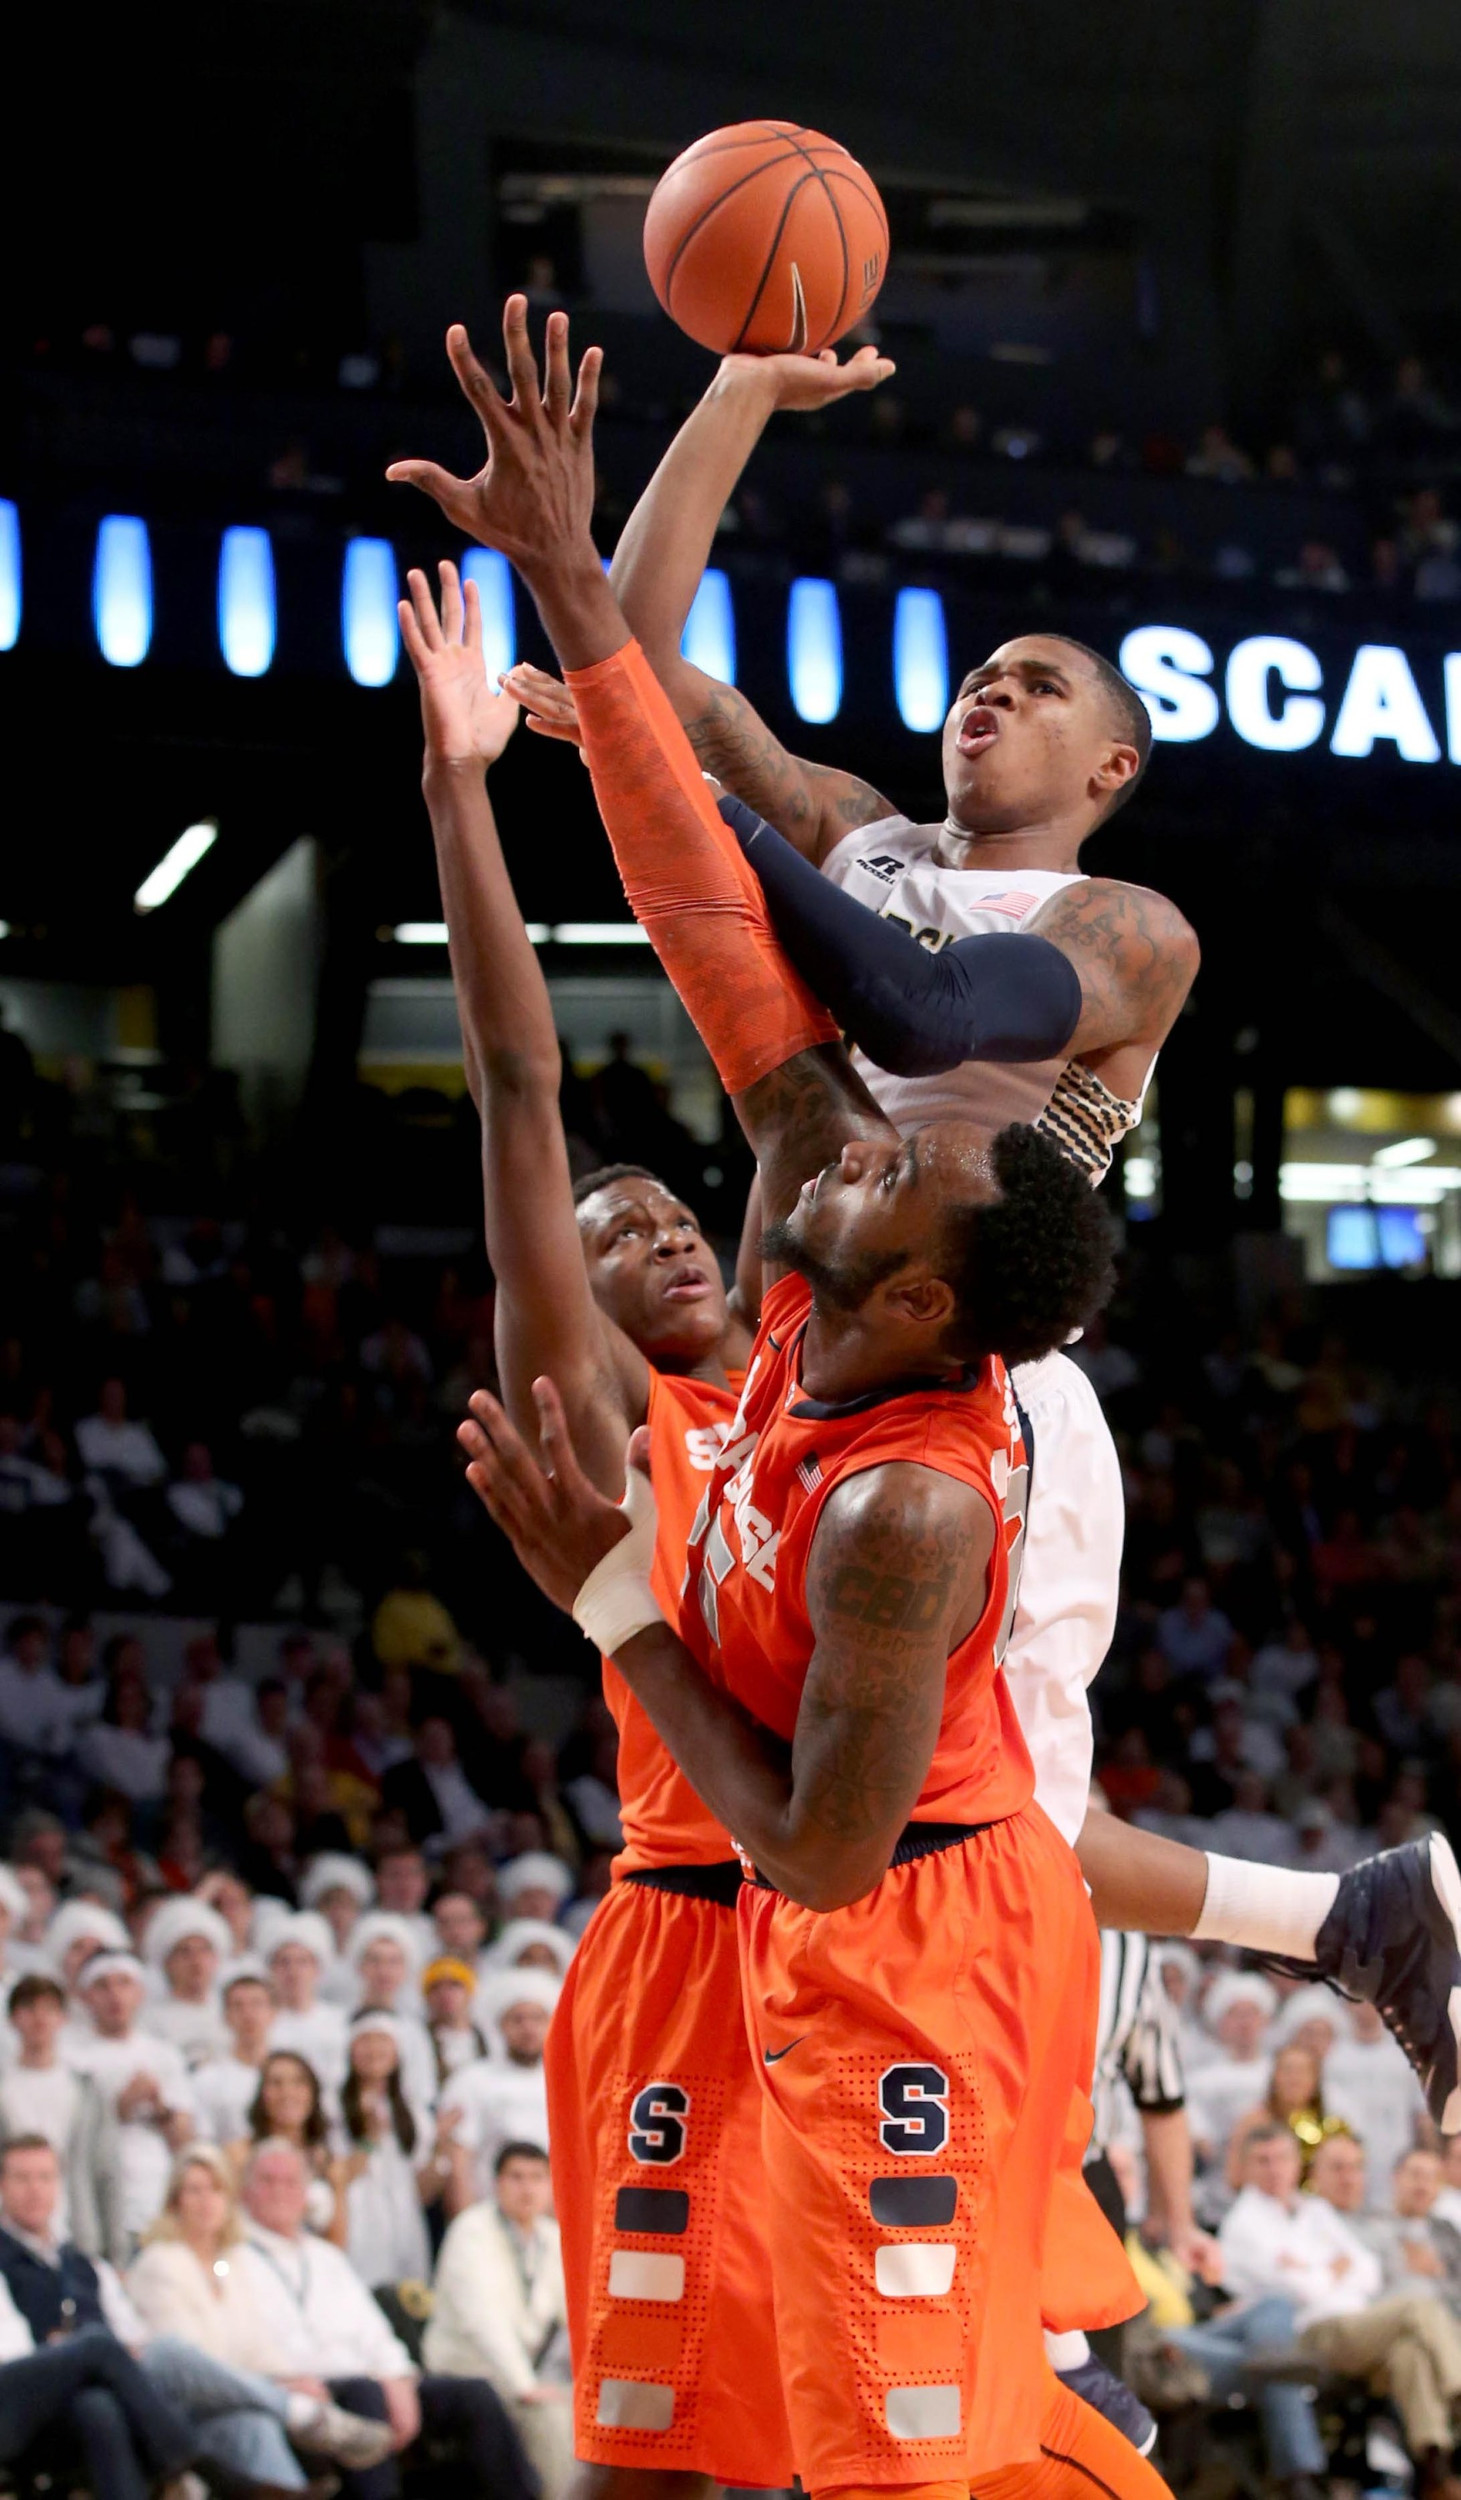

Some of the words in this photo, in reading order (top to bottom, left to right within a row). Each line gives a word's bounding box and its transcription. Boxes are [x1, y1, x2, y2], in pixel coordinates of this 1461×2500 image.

[1119, 625, 1461, 765] SCA
[856, 859, 896, 885] RUSSELL
[628, 2082, 690, 2167] S
[878, 2062, 949, 2157] S
